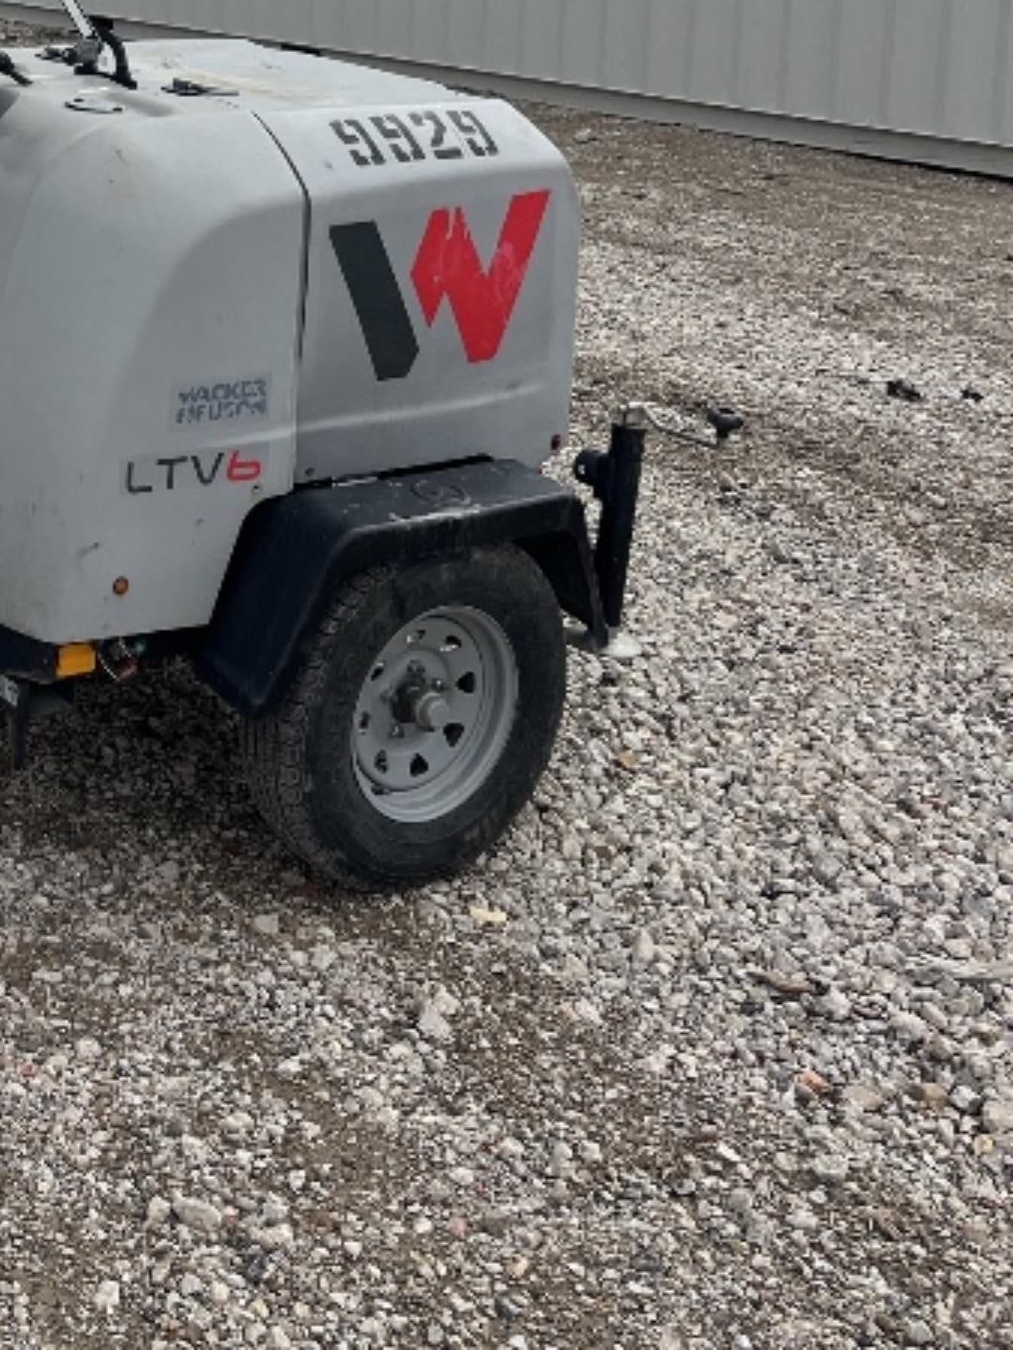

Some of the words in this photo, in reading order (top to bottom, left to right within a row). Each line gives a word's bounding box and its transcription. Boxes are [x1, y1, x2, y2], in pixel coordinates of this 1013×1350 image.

[329, 110, 499, 167] 9929
[178, 378, 268, 405] WACKER
[125, 450, 262, 494] LTV6
